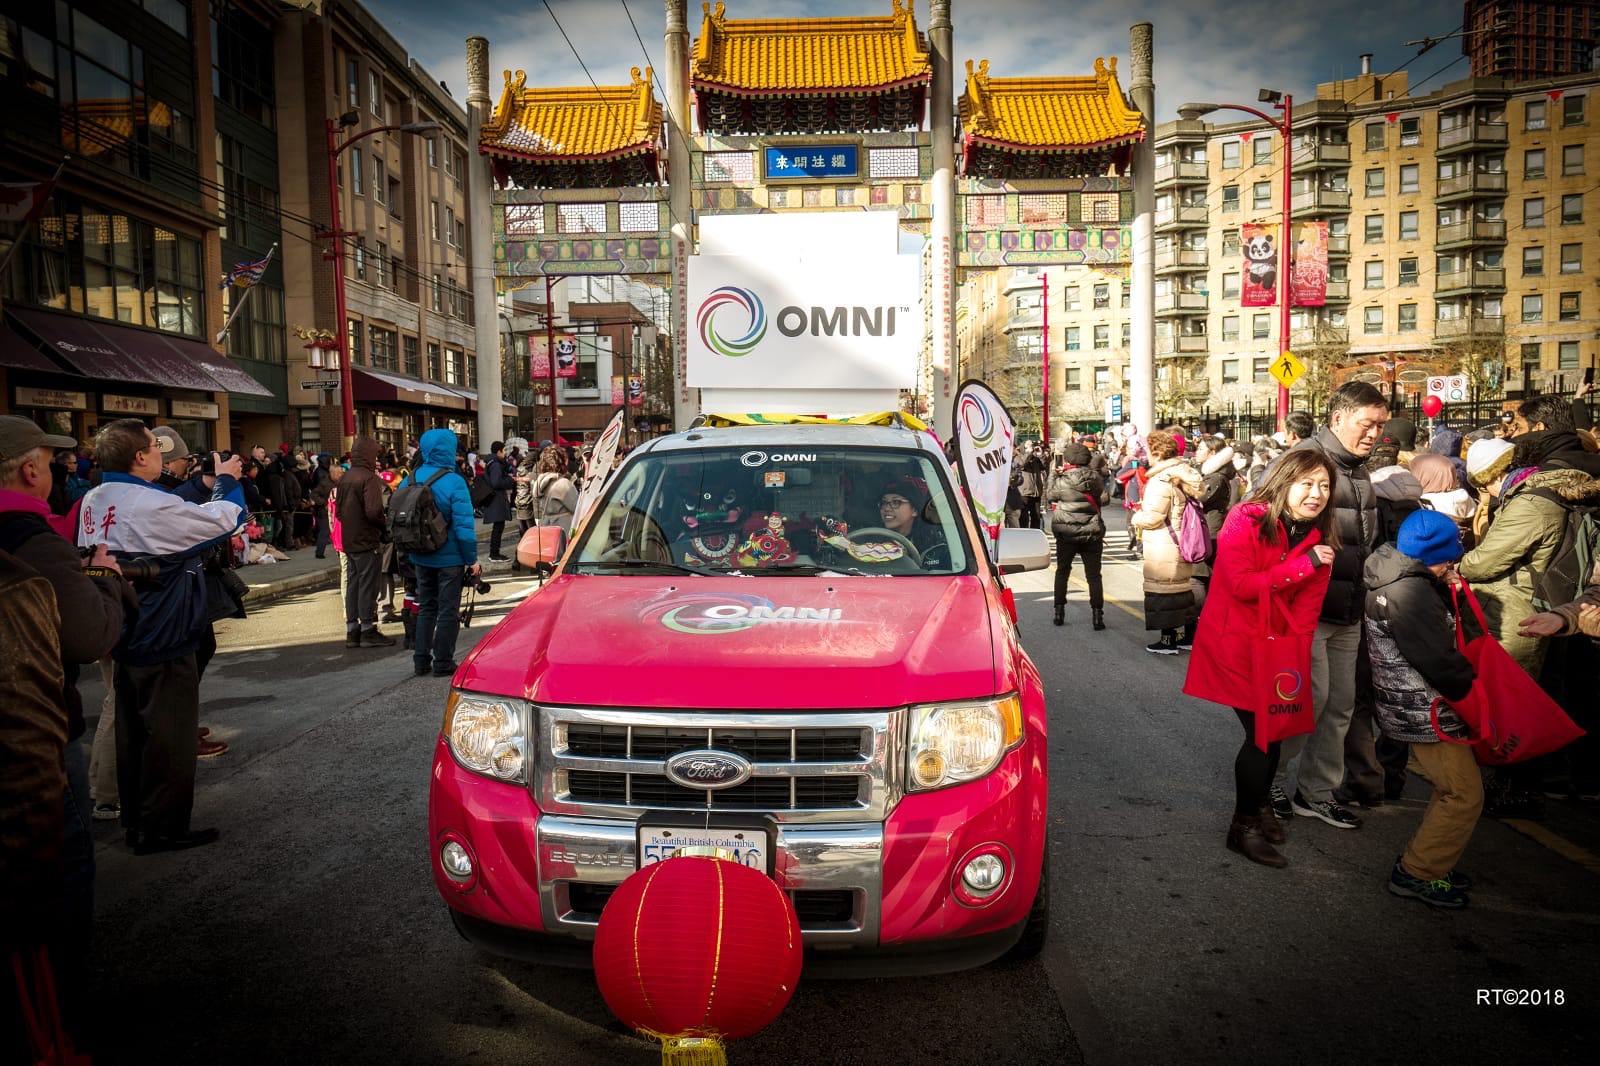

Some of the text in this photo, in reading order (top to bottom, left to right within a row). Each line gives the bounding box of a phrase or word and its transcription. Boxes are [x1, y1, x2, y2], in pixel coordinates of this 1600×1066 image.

[777, 306, 896, 337] OMNI
[771, 454, 817, 462] OMNI
[702, 605, 843, 620] OMNI
[1268, 704, 1303, 715] OMNI
[687, 761, 727, 779] Ford
[652, 836, 755, 849] Beautiful British Columbia
[550, 850, 636, 868] ESCAPE
